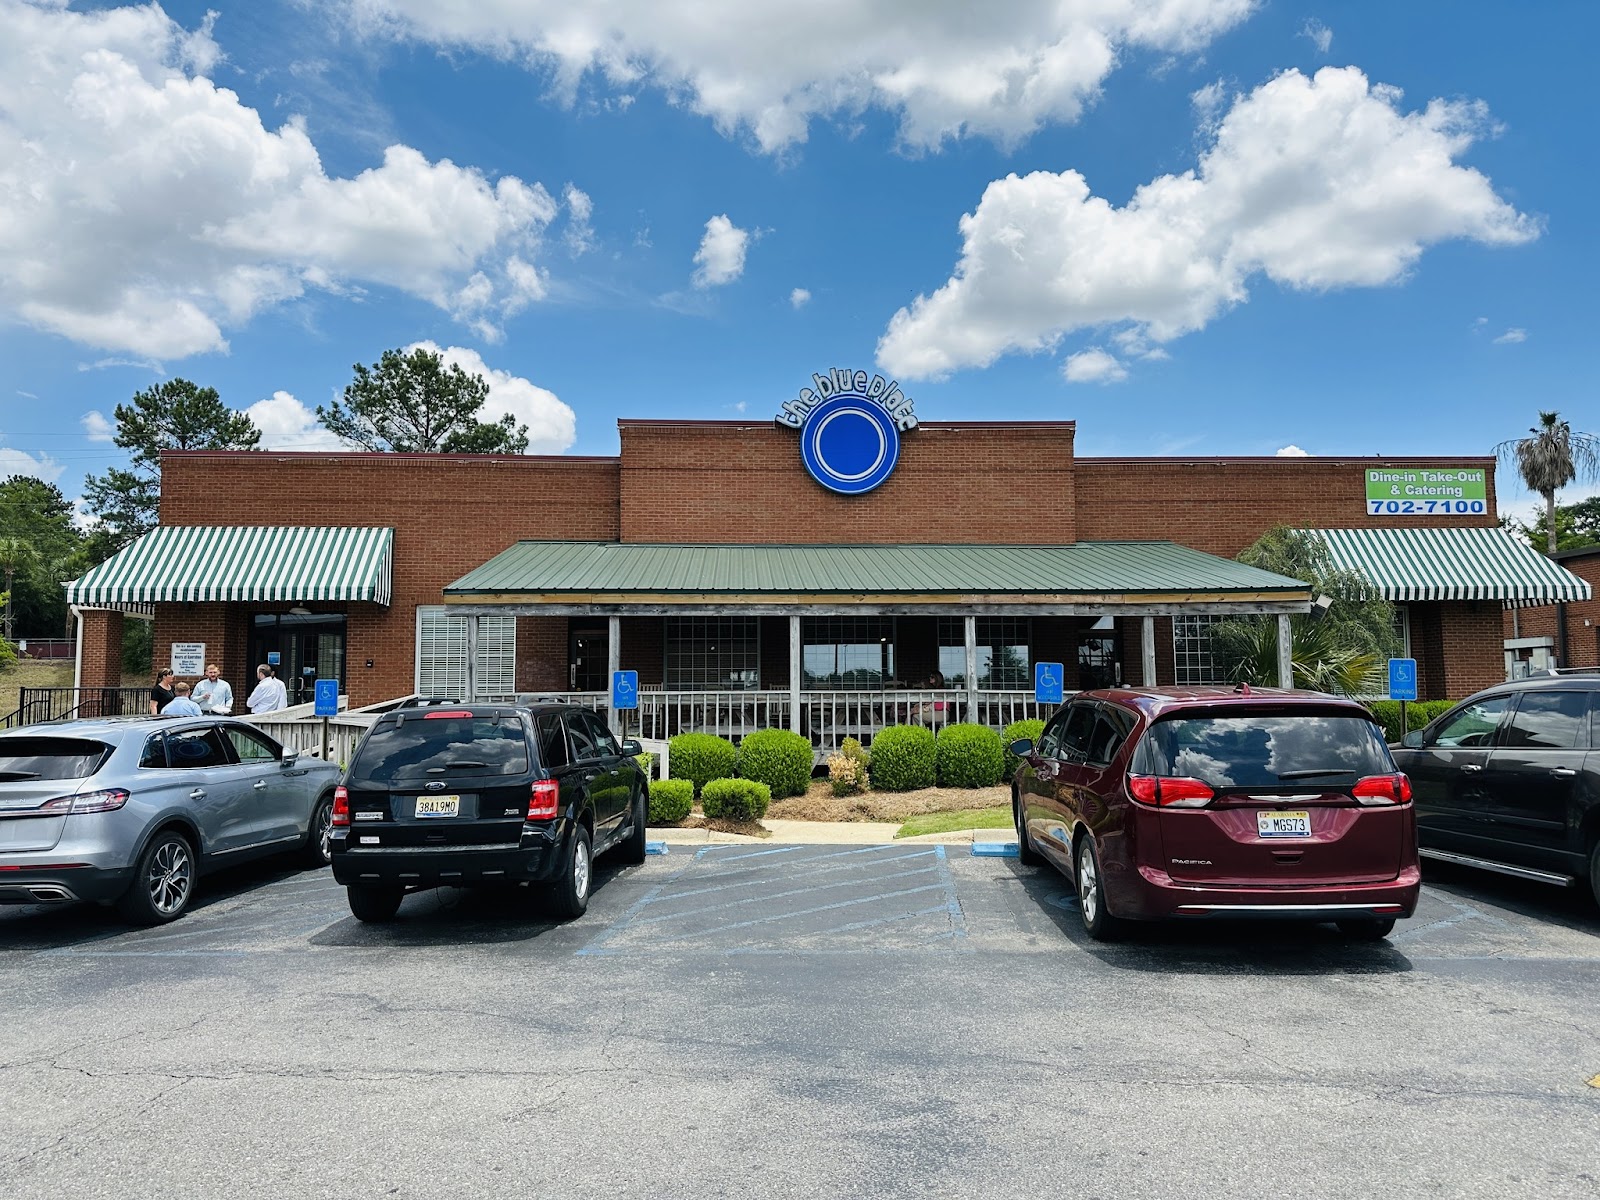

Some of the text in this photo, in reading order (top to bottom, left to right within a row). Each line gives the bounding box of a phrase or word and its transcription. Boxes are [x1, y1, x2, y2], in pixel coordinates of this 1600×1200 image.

[775, 367, 919, 432] the blue plate
[1369, 471, 1482, 482] Dine-in Take-Out
[1390, 484, 1463, 497] & Catering
[1370, 500, 1484, 513] 702-7100
